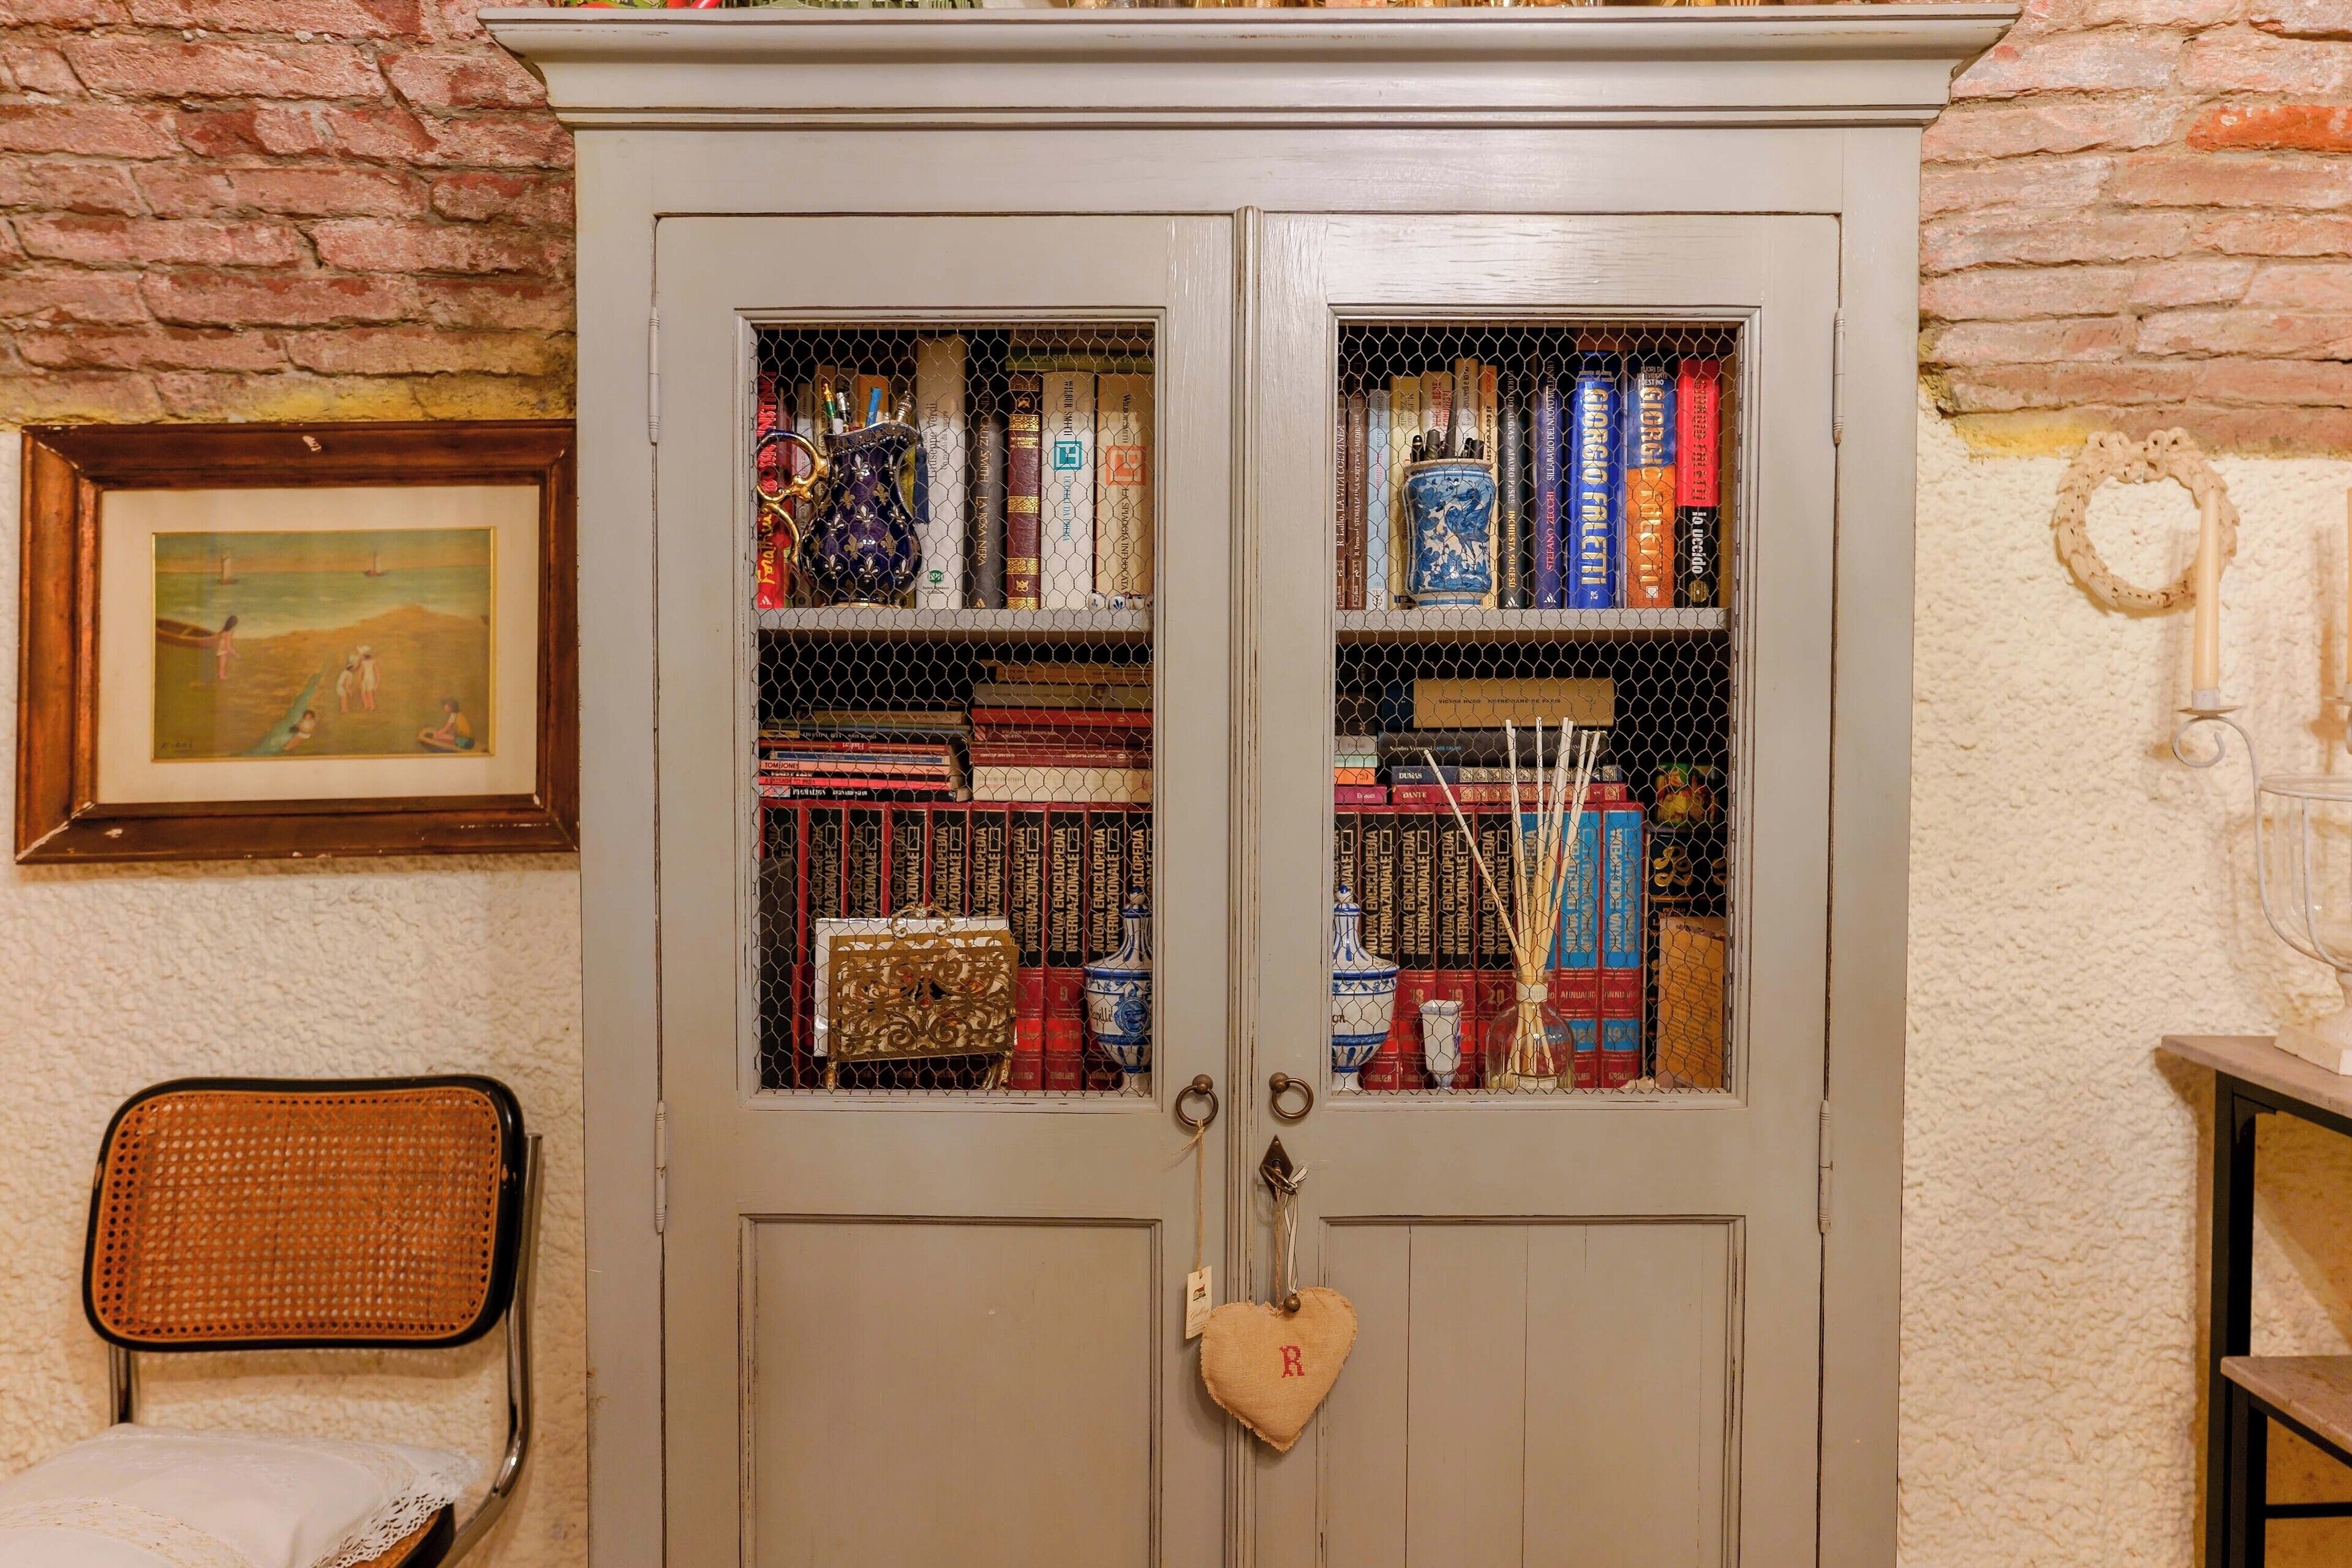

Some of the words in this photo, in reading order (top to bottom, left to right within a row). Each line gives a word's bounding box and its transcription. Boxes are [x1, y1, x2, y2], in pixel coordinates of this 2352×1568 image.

[1547, 399, 1555, 426] NUOVO
[1693, 380, 1708, 439] GIORGIO
[1581, 388, 1608, 484] GIORGIO
[1640, 386, 1665, 481] GIORGIO
[979, 450, 992, 483] SMITH
[1547, 442, 1555, 481] SILLABARIO
[978, 512, 988, 537] ROSA
[1547, 491, 1555, 525] ZECCHI
[1546, 527, 1555, 571] STEFANO
[1691, 529, 1707, 575] uccido
[1053, 827, 1066, 909] ENCICLOPEDIA
[1093, 828, 1106, 909] ENCICLOPEDIA
[1403, 830, 1415, 911] ENCICLOPEDIA
[1442, 830, 1455, 911] ENCICLOPEDIA
[1066, 853, 1080, 952] INTERNAZIONALE
[1379, 856, 1393, 954] INTERNAZIONALE
[1417, 856, 1430, 954] INTERNAZIONALE
[1457, 856, 1469, 954] INTERNAZIONALE
[1052, 911, 1065, 952] NUOVA
[1092, 912, 1105, 952] NUOVA
[1403, 913, 1415, 954] NUOVA
[1442, 913, 1455, 954] NUOVA
[1279, 1345, 1305, 1378] R
